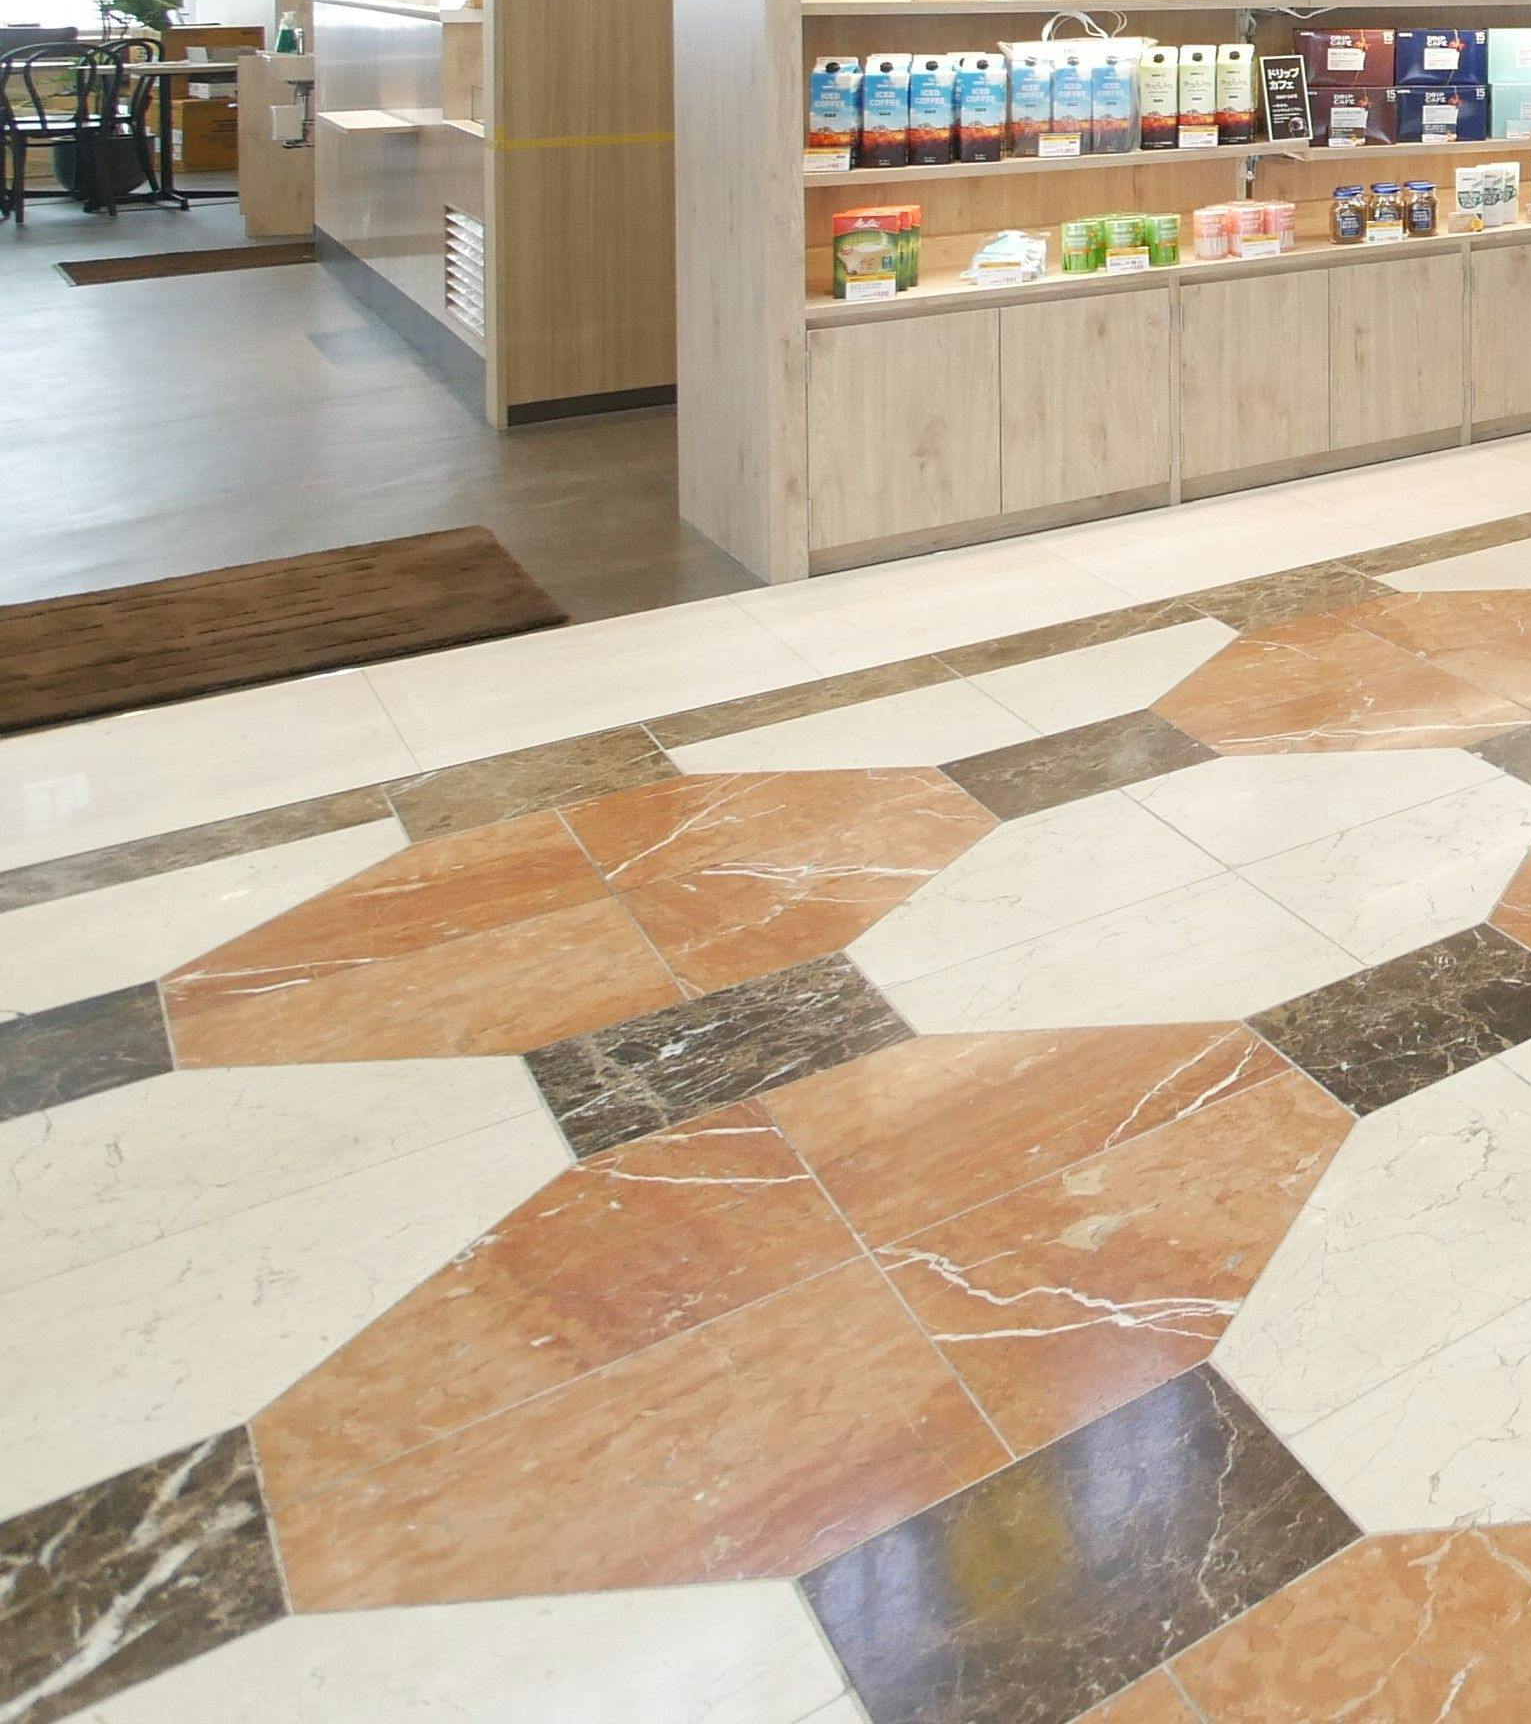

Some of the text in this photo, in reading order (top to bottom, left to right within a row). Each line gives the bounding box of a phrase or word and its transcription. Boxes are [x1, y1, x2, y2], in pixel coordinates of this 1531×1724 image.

[1267, 67, 1299, 80] ドリップ
[1269, 80, 1295, 90] カフェ
